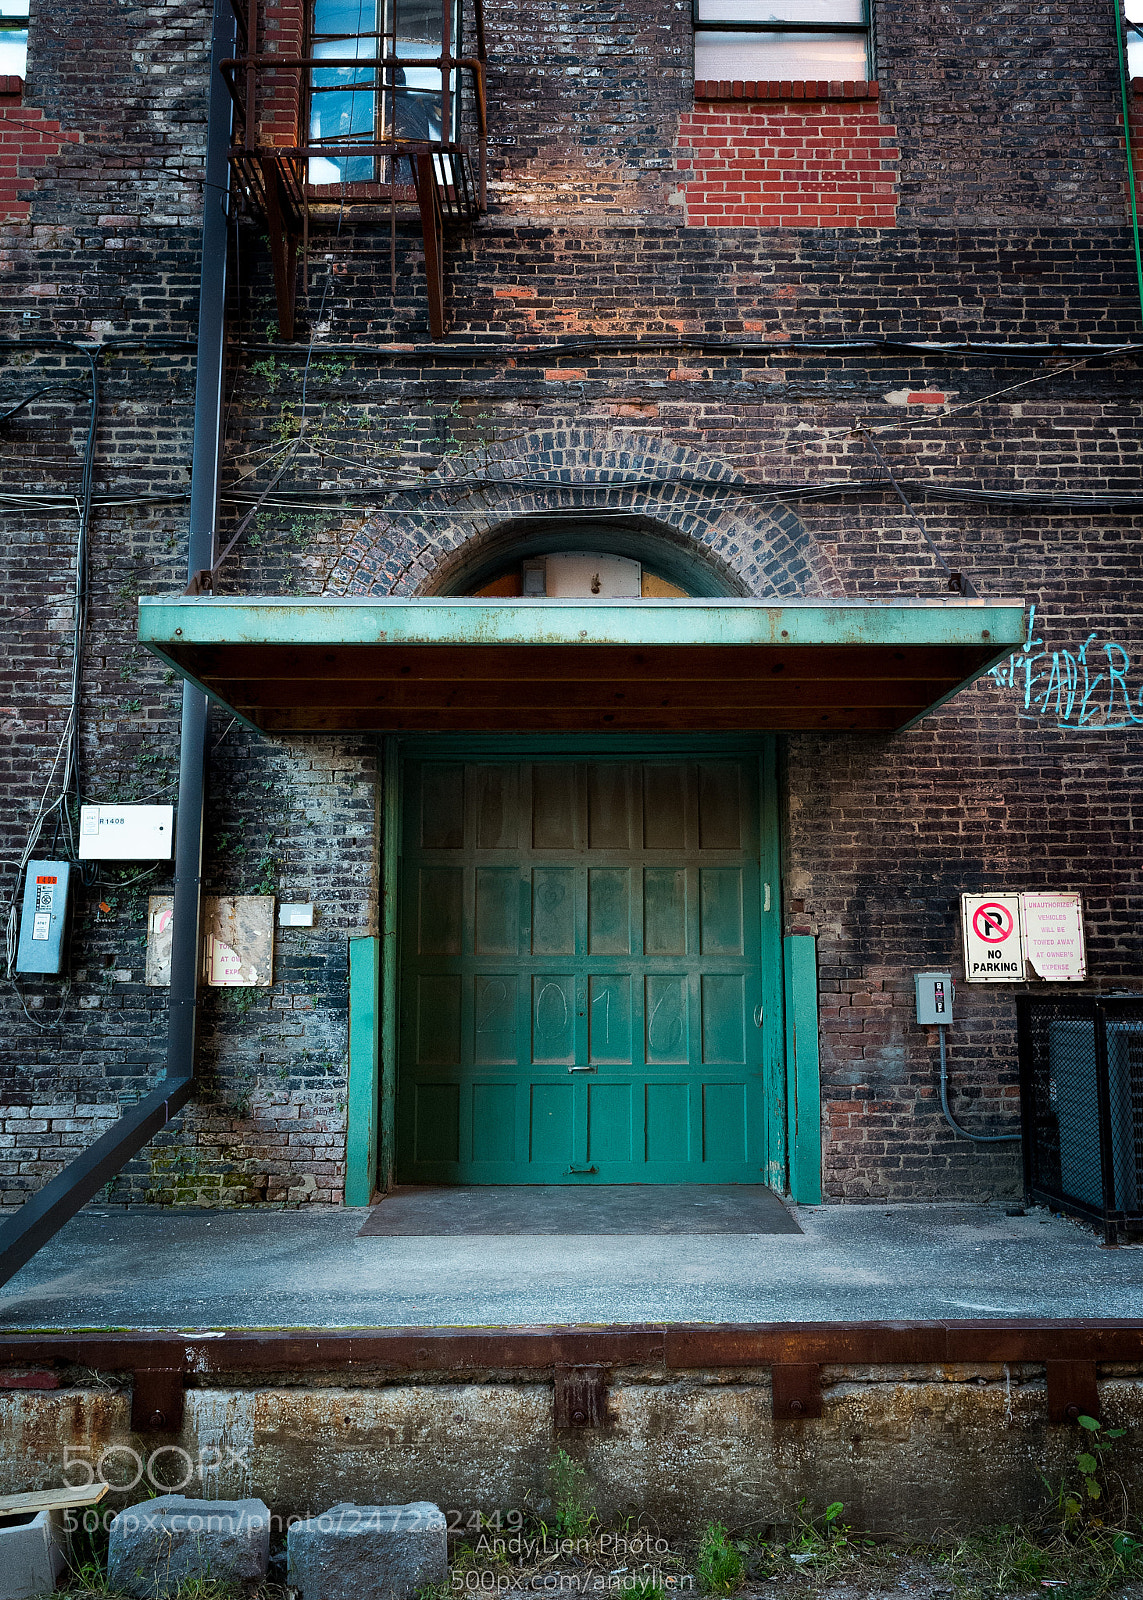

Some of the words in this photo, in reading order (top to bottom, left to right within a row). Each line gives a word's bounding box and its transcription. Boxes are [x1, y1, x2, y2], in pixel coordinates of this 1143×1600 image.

[1028, 901, 1074, 909] UNAUTHORIZED
[987, 949, 1002, 959] NO
[973, 962, 1018, 972] PARKING
